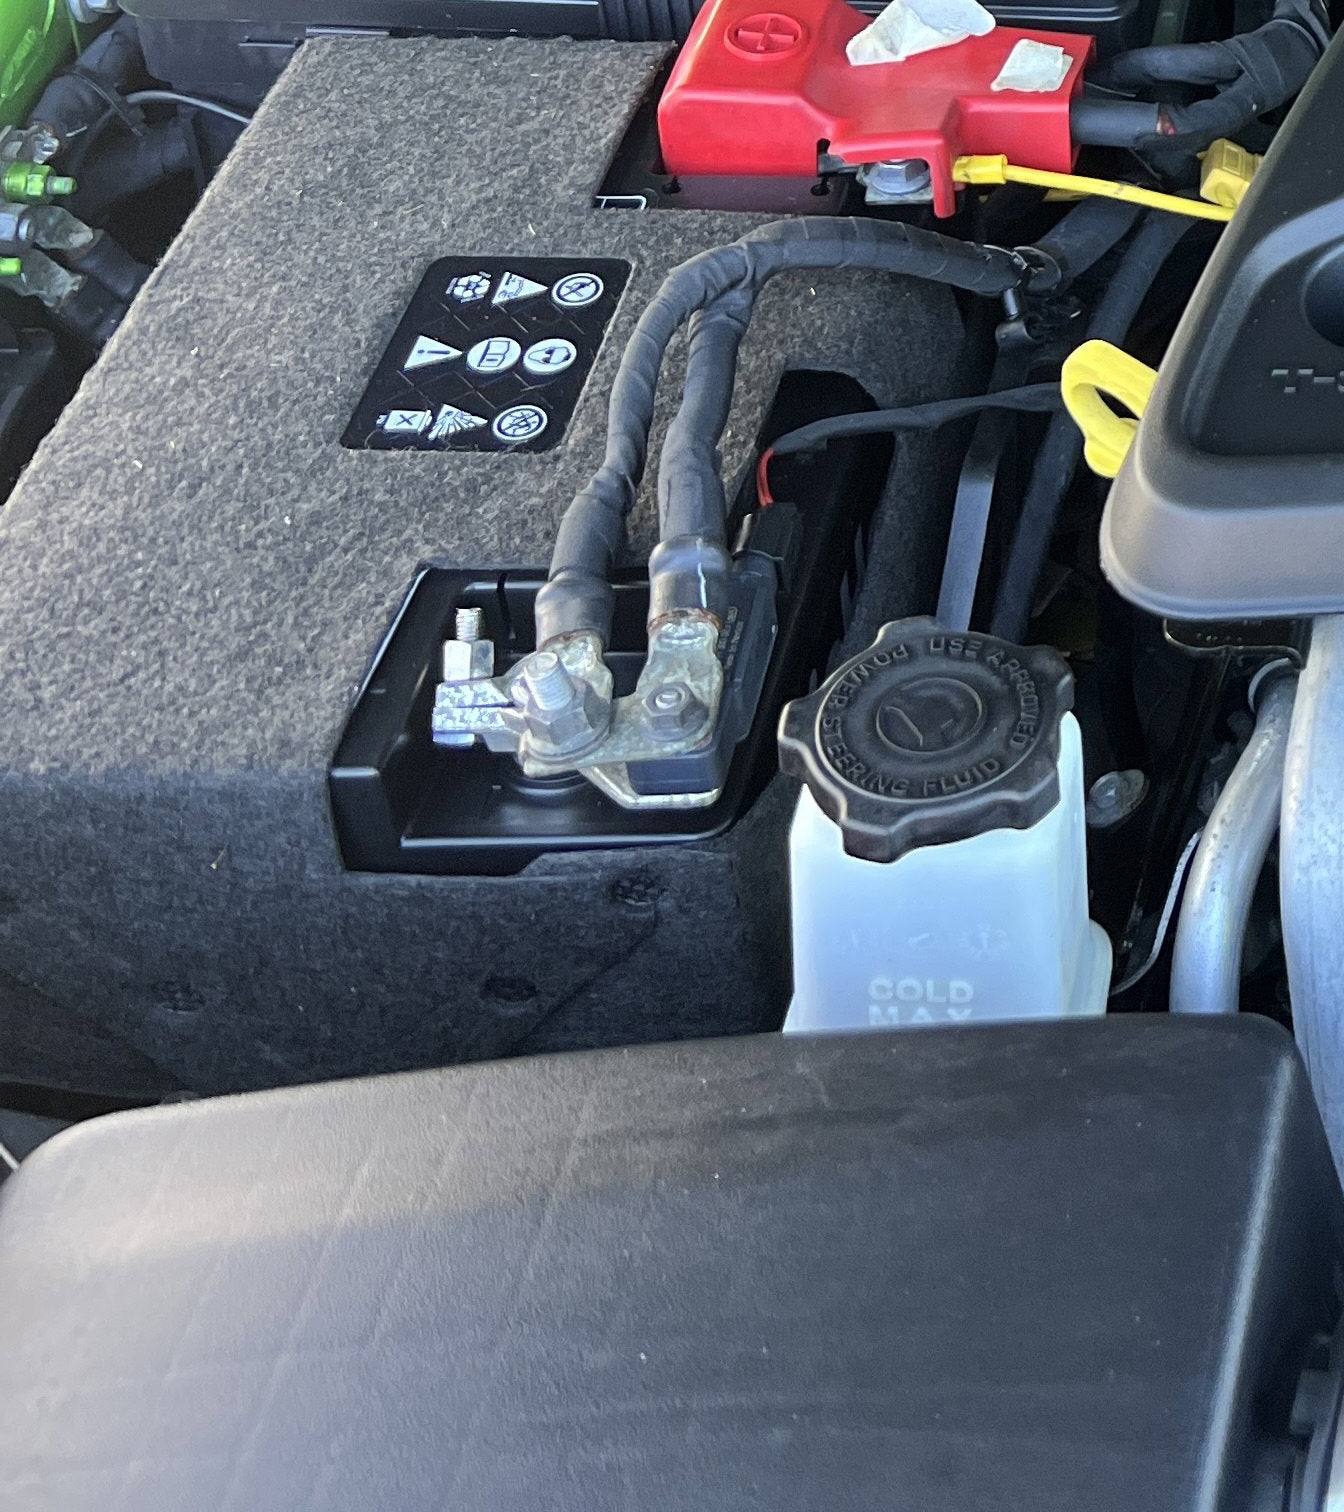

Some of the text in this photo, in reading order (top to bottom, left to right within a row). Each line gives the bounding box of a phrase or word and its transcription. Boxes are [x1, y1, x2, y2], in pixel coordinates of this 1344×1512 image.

[823, 643, 1000, 796] POWER STEERING FLUID
[930, 637, 1041, 749] USE APPROVED
[868, 977, 974, 1004] COLD
